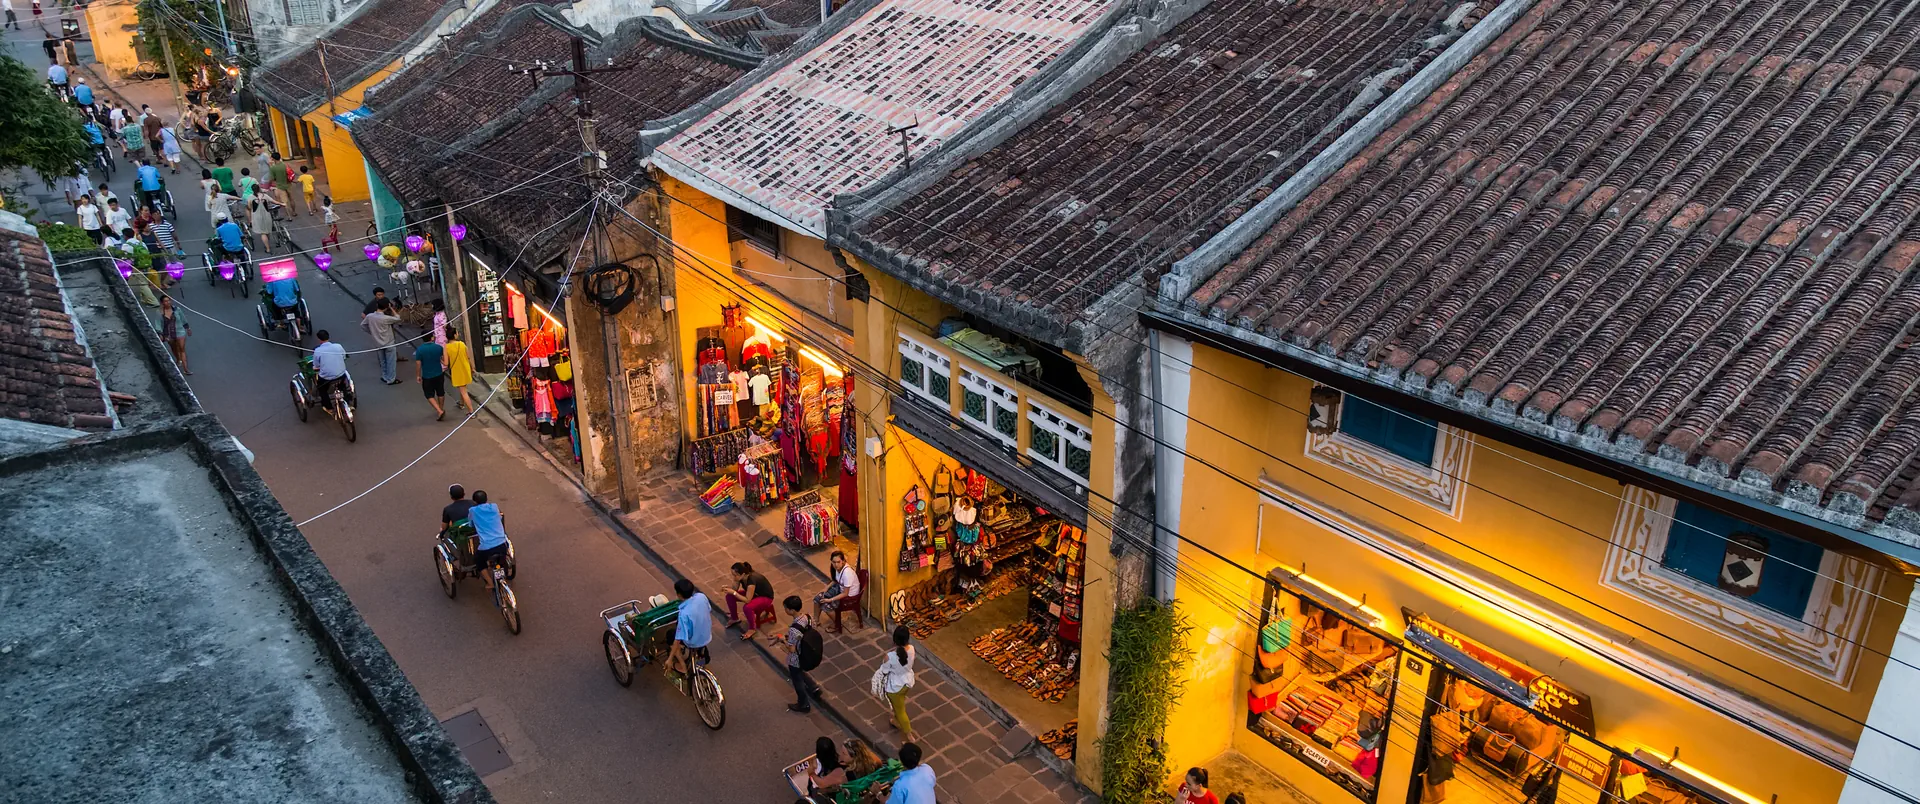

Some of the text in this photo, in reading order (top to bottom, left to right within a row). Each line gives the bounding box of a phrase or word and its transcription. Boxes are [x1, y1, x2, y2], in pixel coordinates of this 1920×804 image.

[1305, 747, 1329, 765] SCARVES
[1563, 747, 1605, 776] CLOTHING STORE
[796, 760, 810, 773] 043
